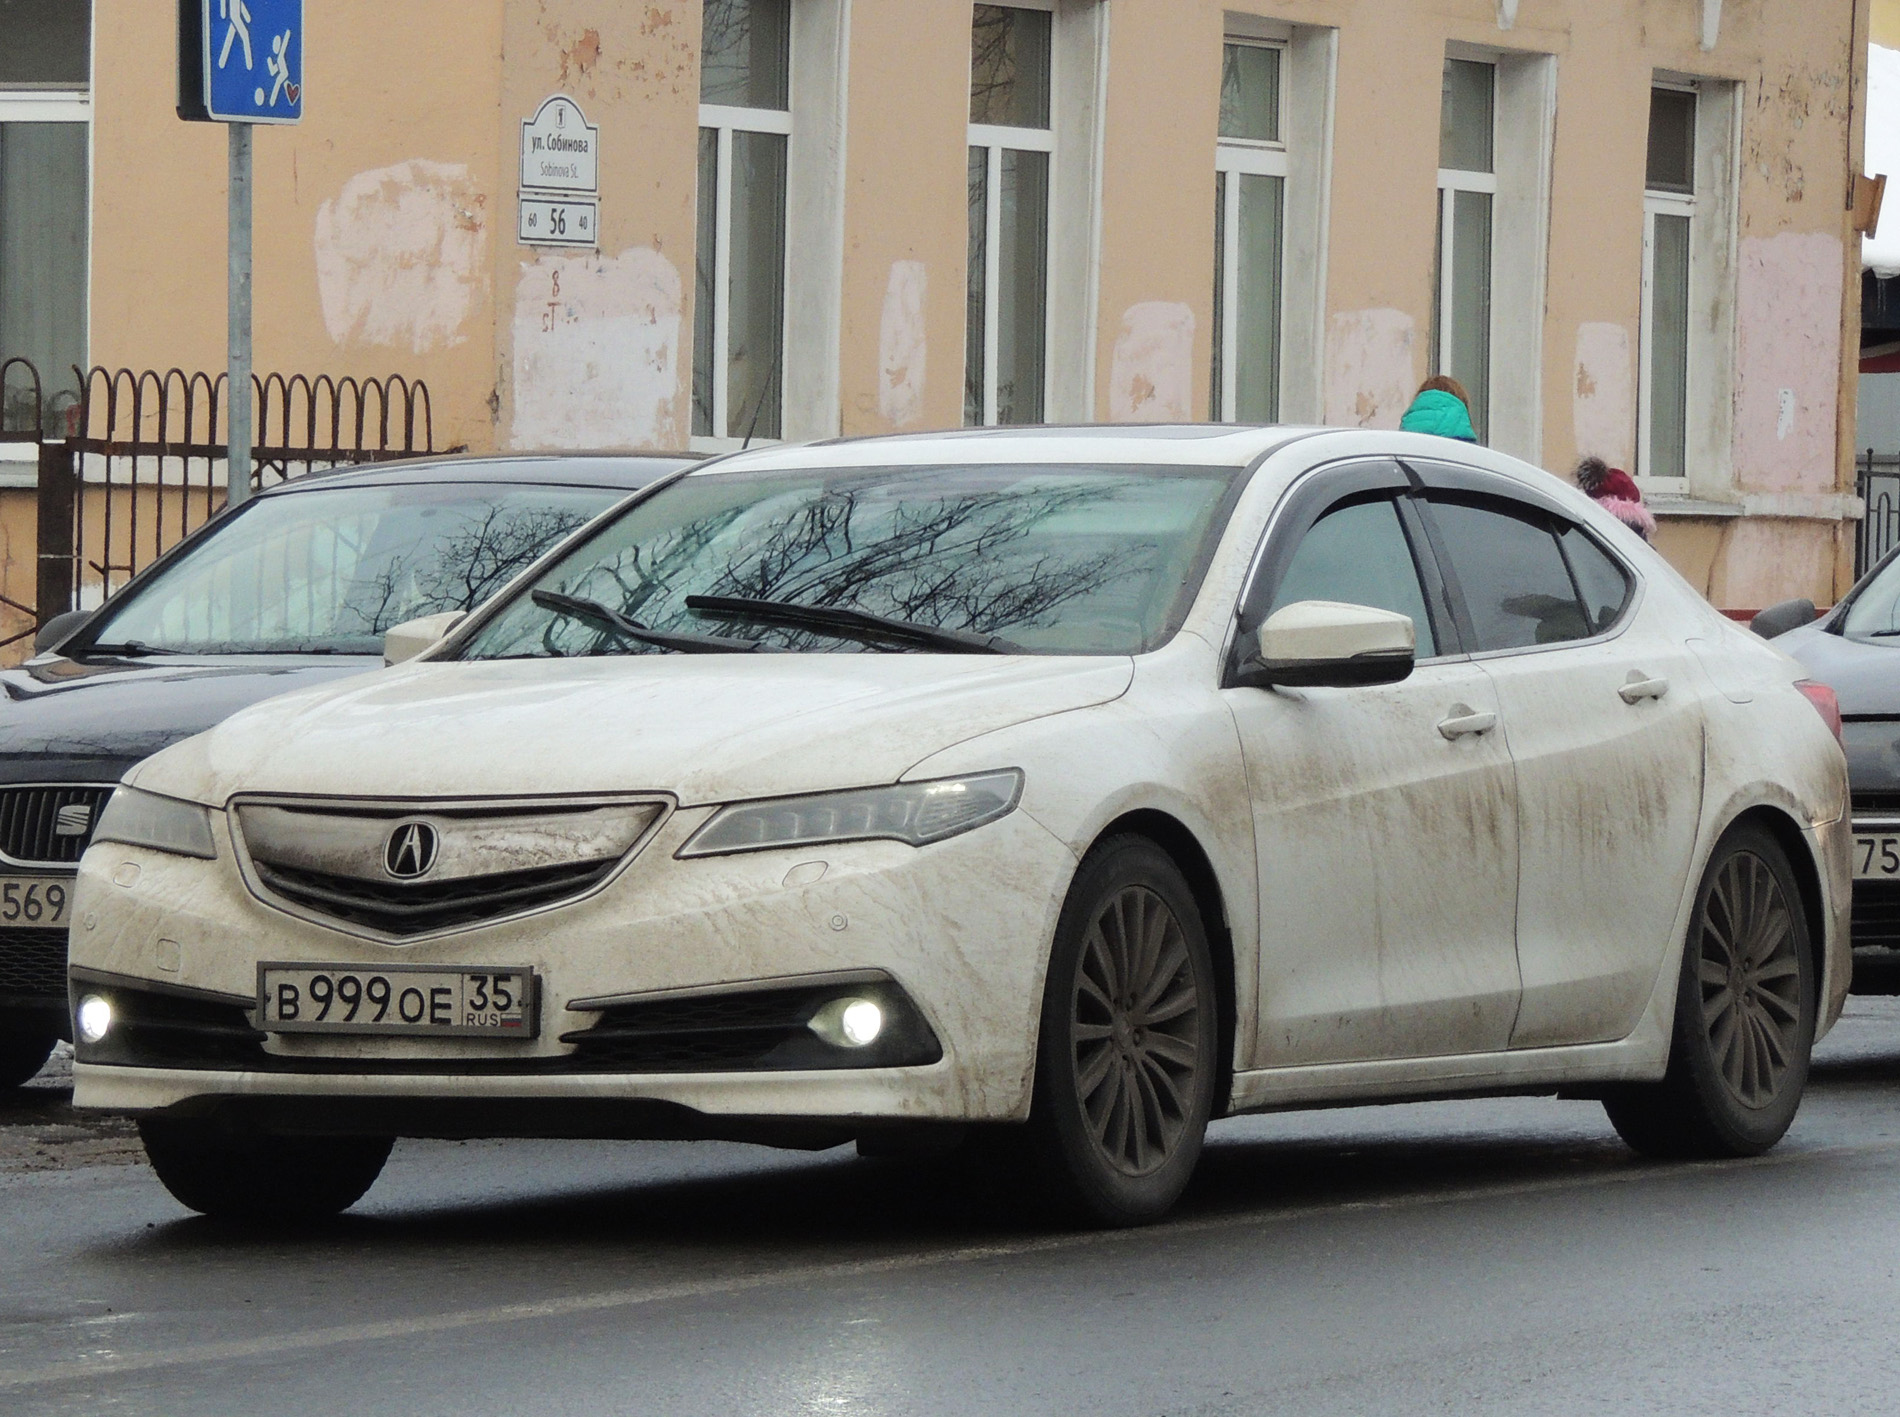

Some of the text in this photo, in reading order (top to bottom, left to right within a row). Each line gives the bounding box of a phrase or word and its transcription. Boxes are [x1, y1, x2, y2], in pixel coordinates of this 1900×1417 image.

[532, 133, 588, 154] ул. Собинова
[540, 161, 569, 178] Sobinova
[528, 208, 588, 235] 60 56 40
[1857, 838, 1900, 875] 75
[2, 883, 66, 922] 569
[469, 975, 512, 1011] 35
[466, 1012, 498, 1027] RUS
